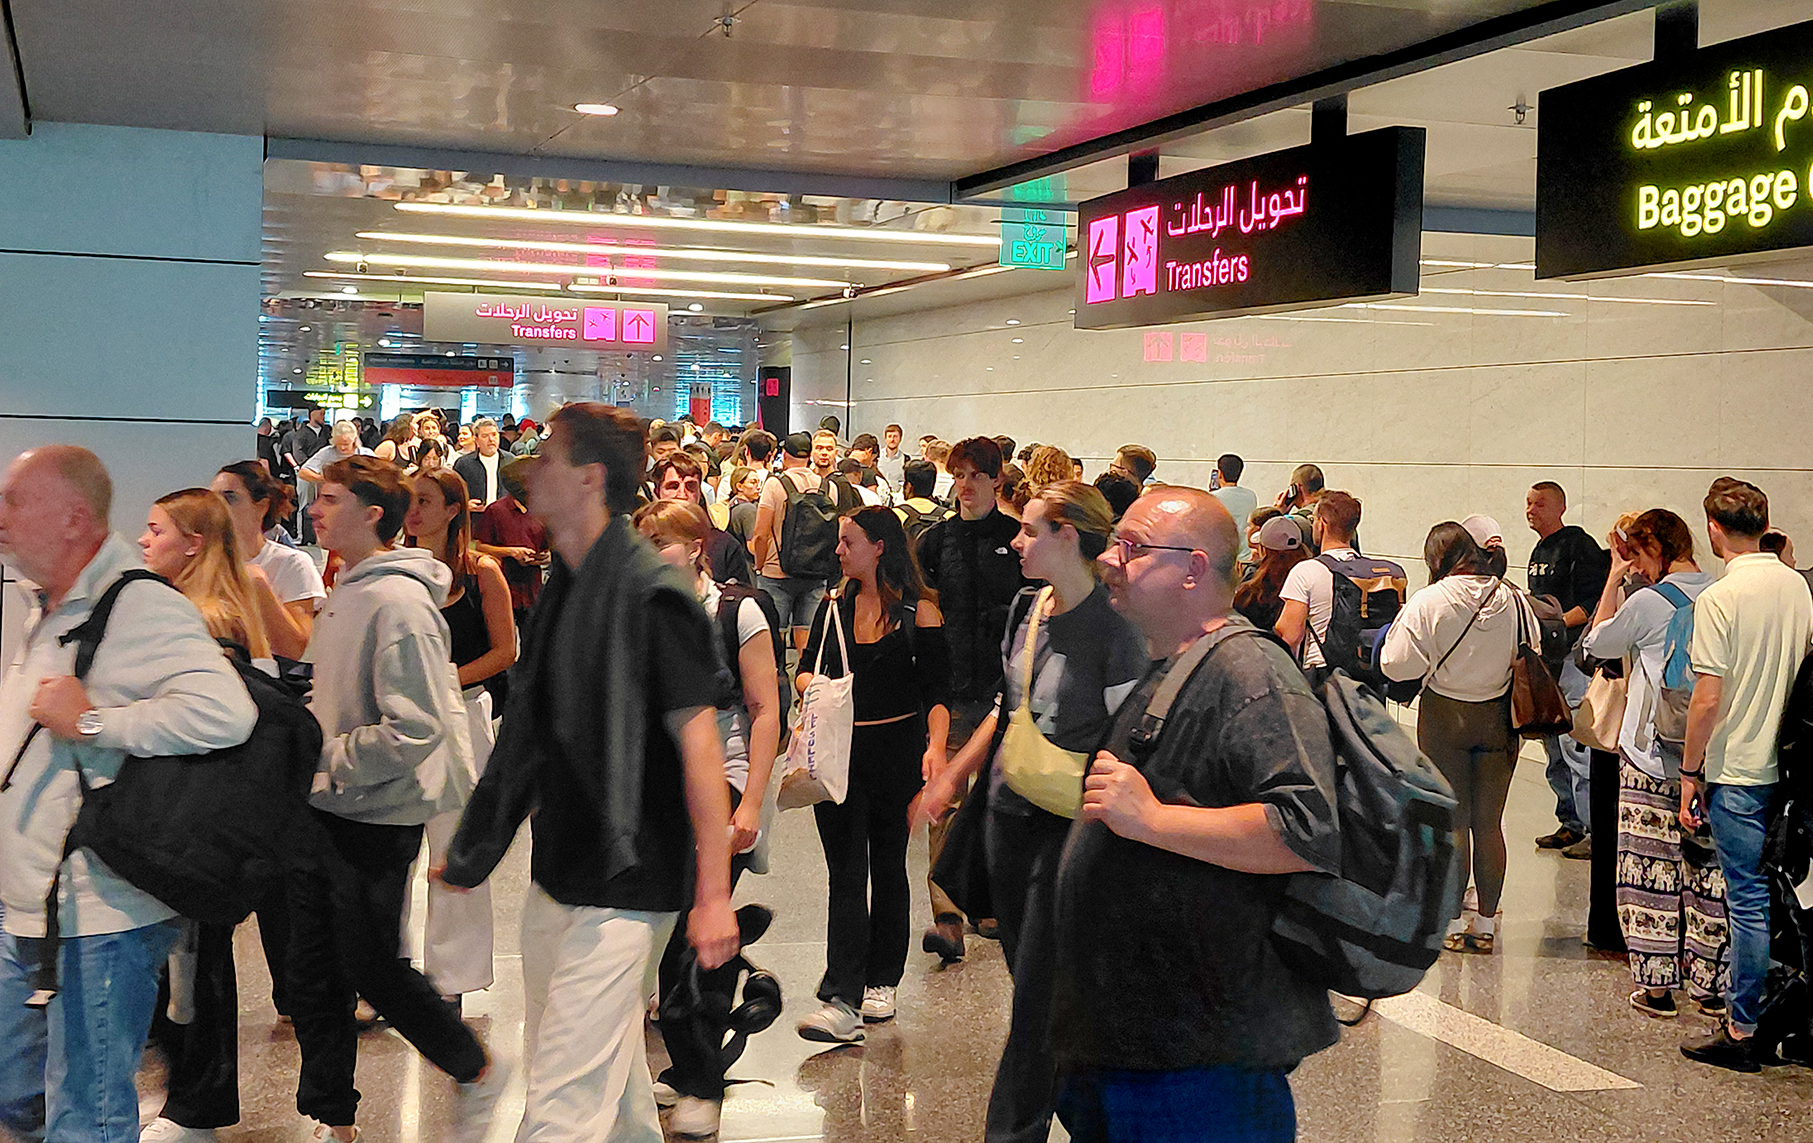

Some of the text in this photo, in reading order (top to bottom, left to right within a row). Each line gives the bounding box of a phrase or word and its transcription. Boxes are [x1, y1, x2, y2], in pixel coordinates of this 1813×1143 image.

[1632, 68, 1764, 150] الأمتعة
[1167, 176, 1307, 239] تحويل الرحلات
[1638, 168, 1798, 237] Baggage
[1012, 241, 1054, 264] EXIT
[1166, 248, 1249, 292] Transfers
[475, 302, 578, 323] تحويل الرحلات
[511, 324, 577, 339] Transfers
